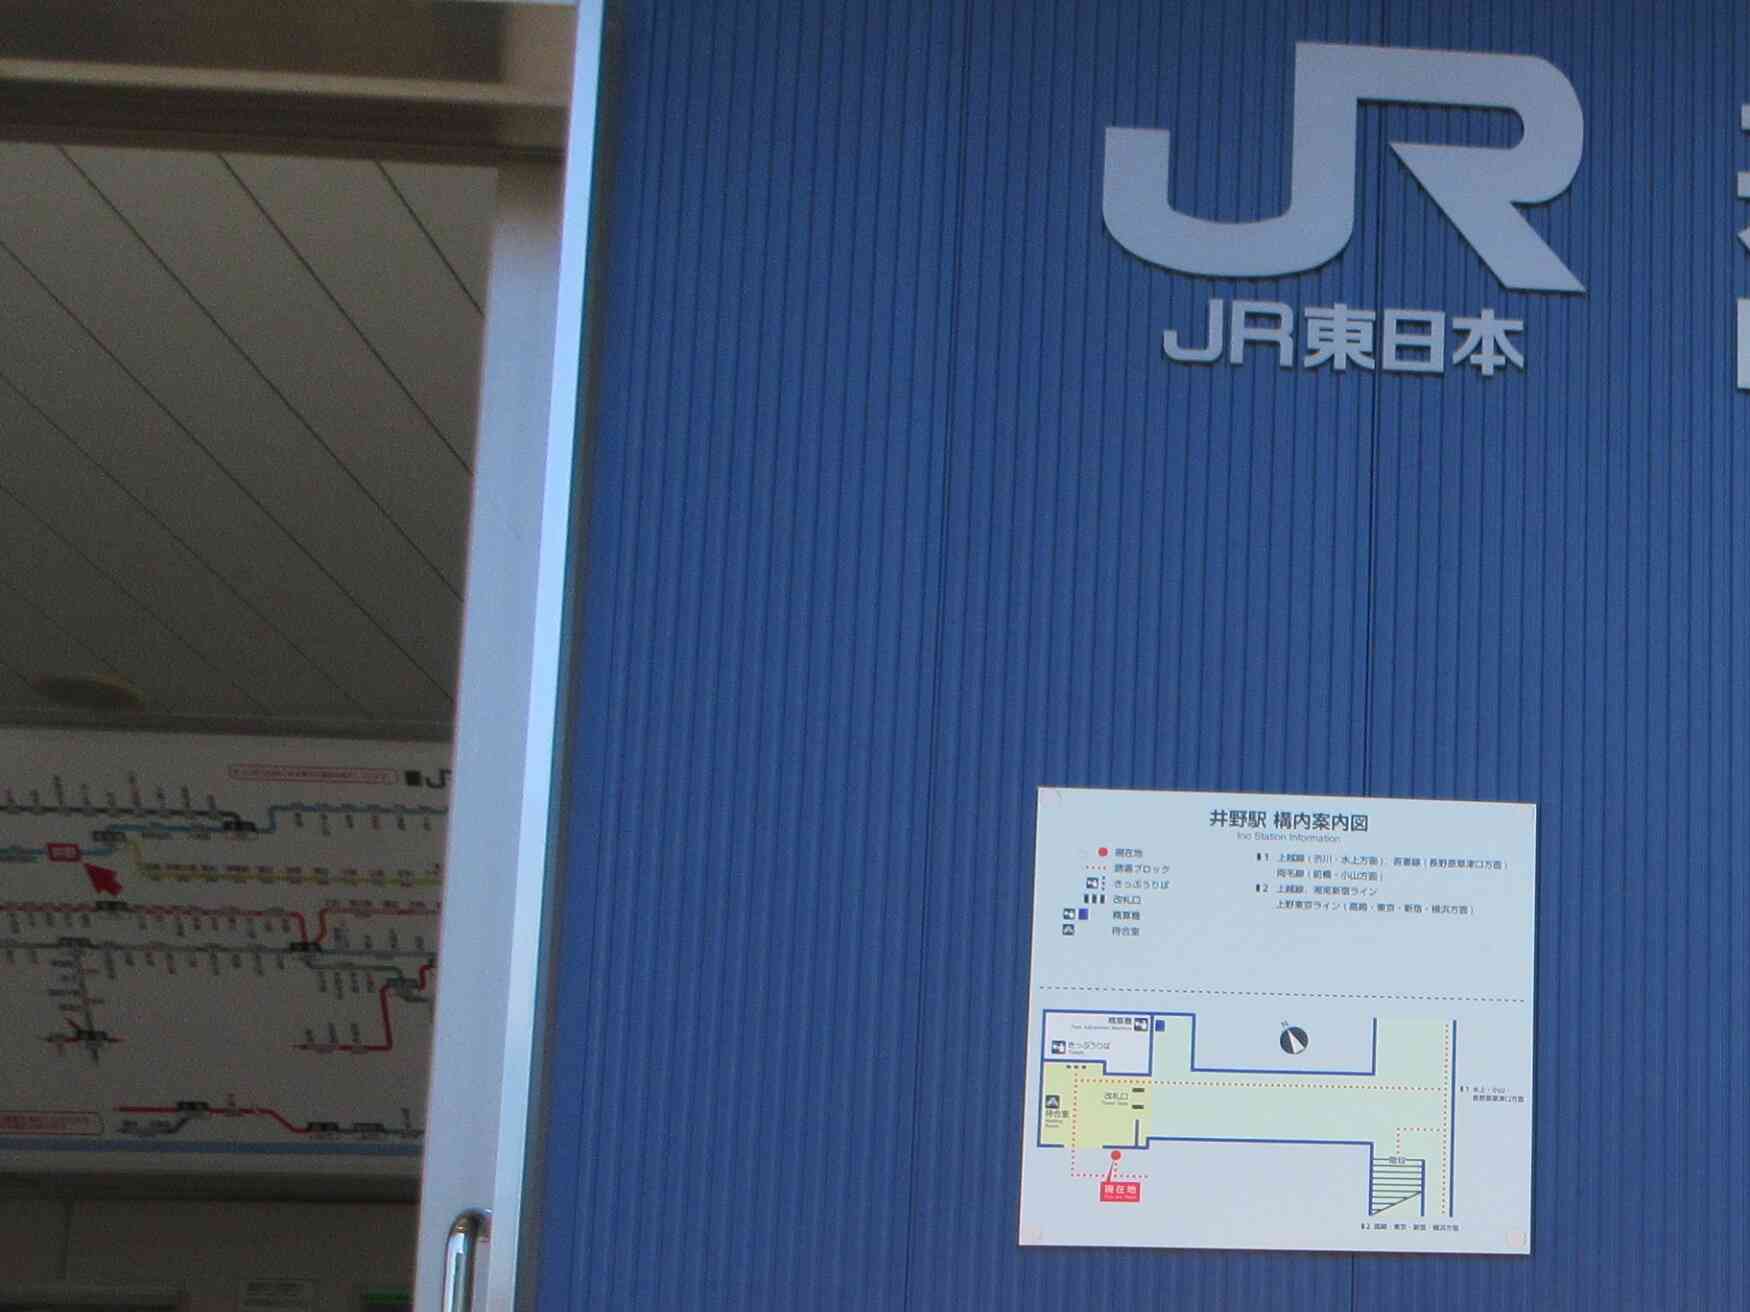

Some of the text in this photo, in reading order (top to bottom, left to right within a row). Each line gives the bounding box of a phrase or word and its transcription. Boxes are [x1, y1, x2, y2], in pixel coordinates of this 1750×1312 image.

[1102, 43, 1584, 291] JR
[1163, 299, 1525, 376] JR東日本
[1209, 809, 1369, 832] 井野駅 構内案内図
